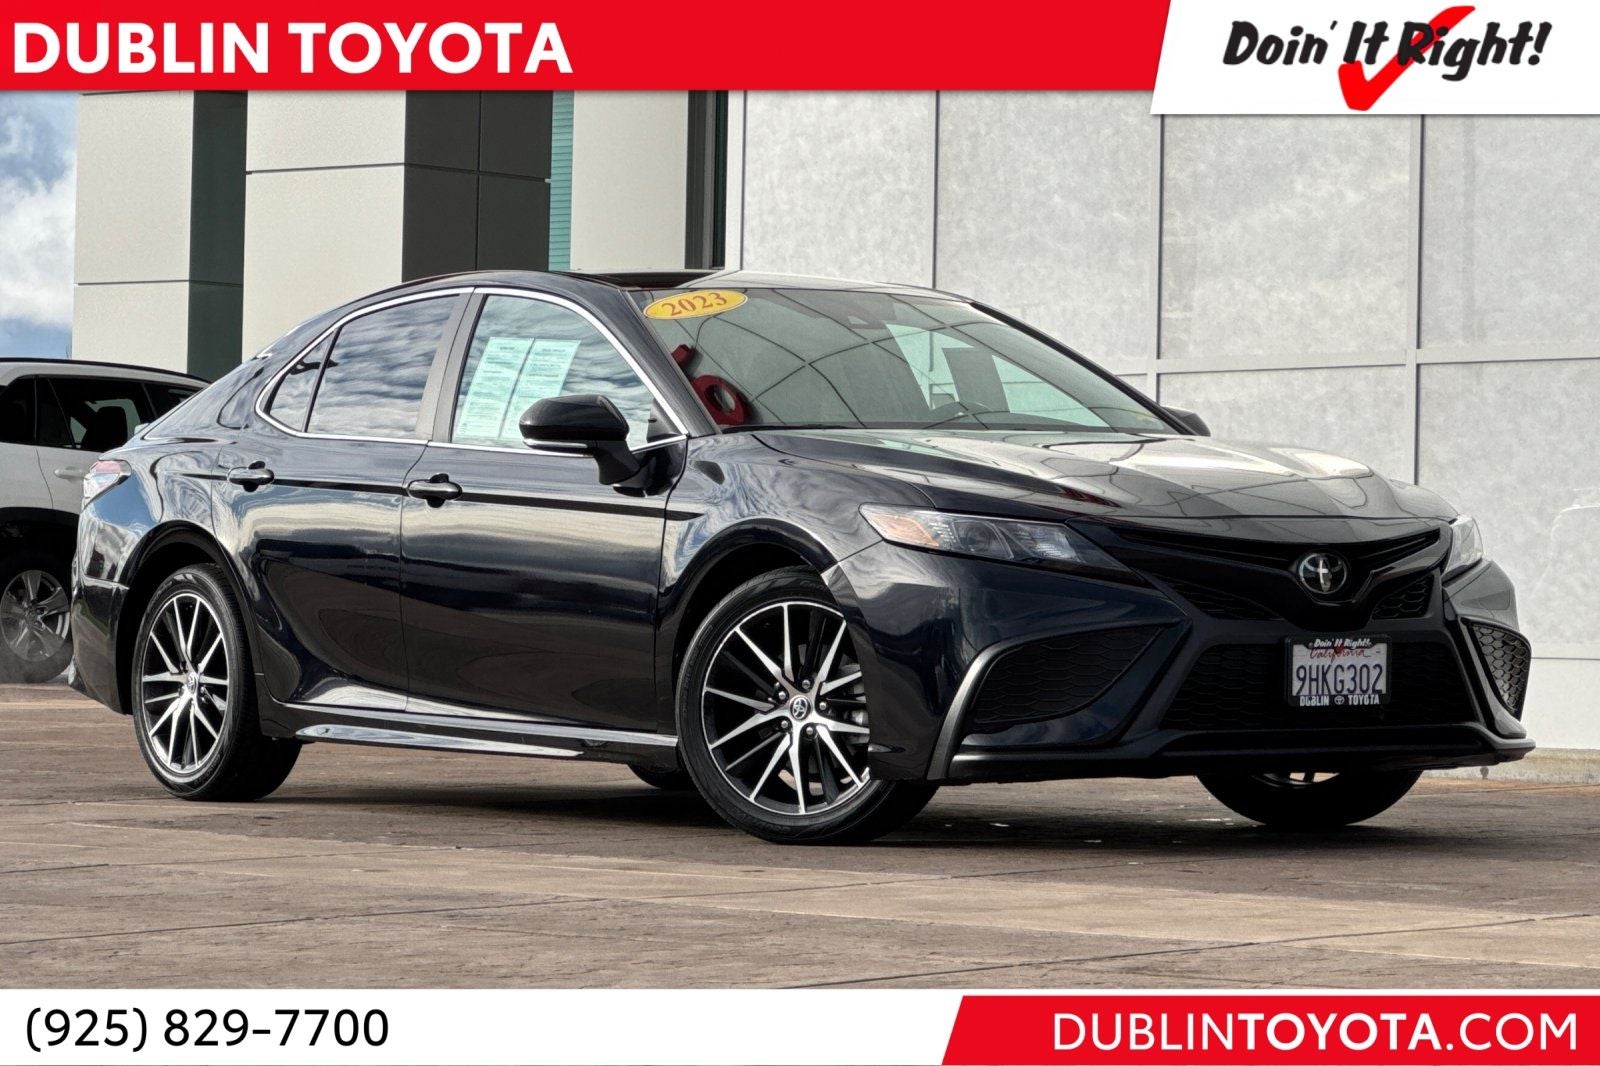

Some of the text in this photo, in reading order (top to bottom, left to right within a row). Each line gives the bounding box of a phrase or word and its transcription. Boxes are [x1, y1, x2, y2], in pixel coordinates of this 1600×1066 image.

[662, 292, 727, 316] 2023
[1296, 663, 1383, 696] 9HKG302
[1300, 694, 1380, 707] DUBLIN TOYOTA
